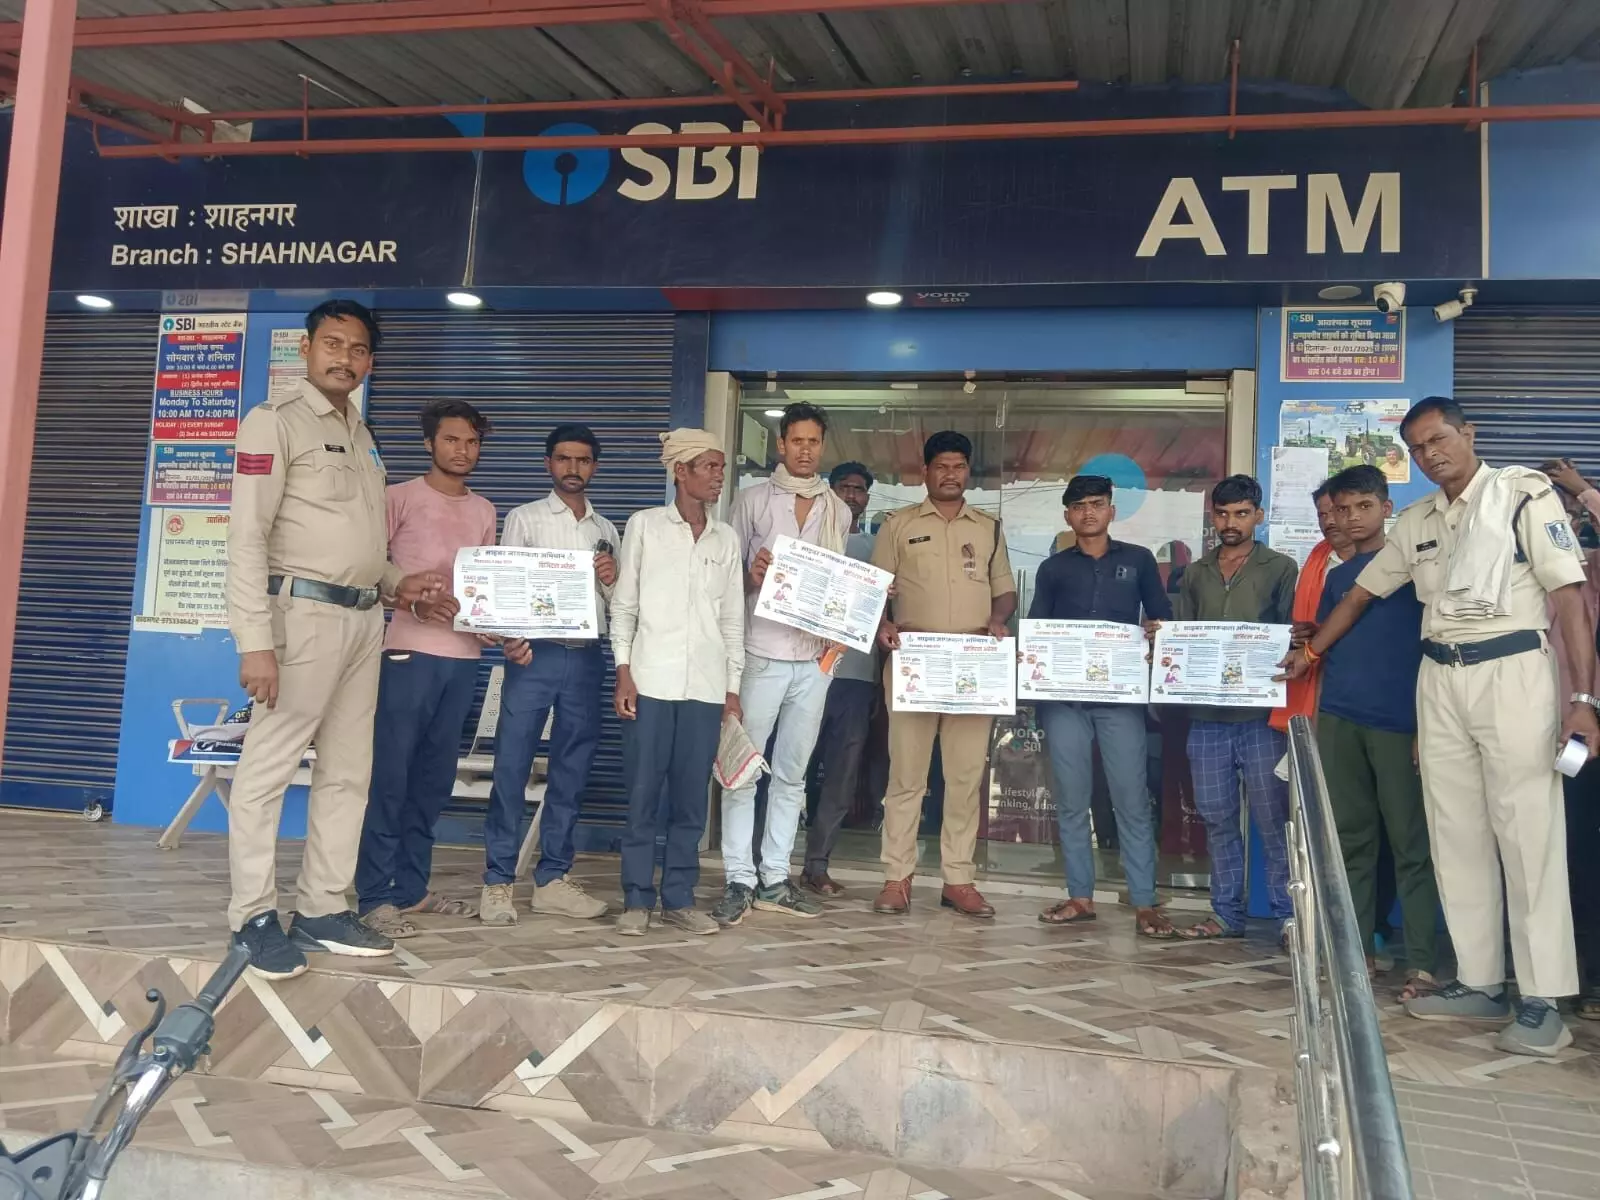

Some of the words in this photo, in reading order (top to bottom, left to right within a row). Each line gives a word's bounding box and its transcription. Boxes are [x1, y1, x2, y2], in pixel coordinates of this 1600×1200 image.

[617, 120, 760, 201] SBI
[113, 205, 179, 231] शाखा
[204, 203, 297, 232] शाहनगर
[1135, 172, 1400, 256] ATM
[111, 243, 198, 266] Branch
[221, 240, 397, 265] SHAHNAGAR
[175, 318, 196, 331] SBI
[1299, 314, 1314, 322] SBI
[166, 351, 194, 363] सोमवार
[197, 351, 205, 362] से
[207, 351, 235, 362] शनिवार
[159, 397, 189, 408] Monday
[192, 397, 200, 406] To
[202, 397, 236, 408] Saturday
[158, 409, 178, 418] 10:00
[179, 409, 191, 418] AM
[193, 409, 204, 418] TO
[205, 409, 222, 418] 4:00
[222, 409, 235, 418] PM
